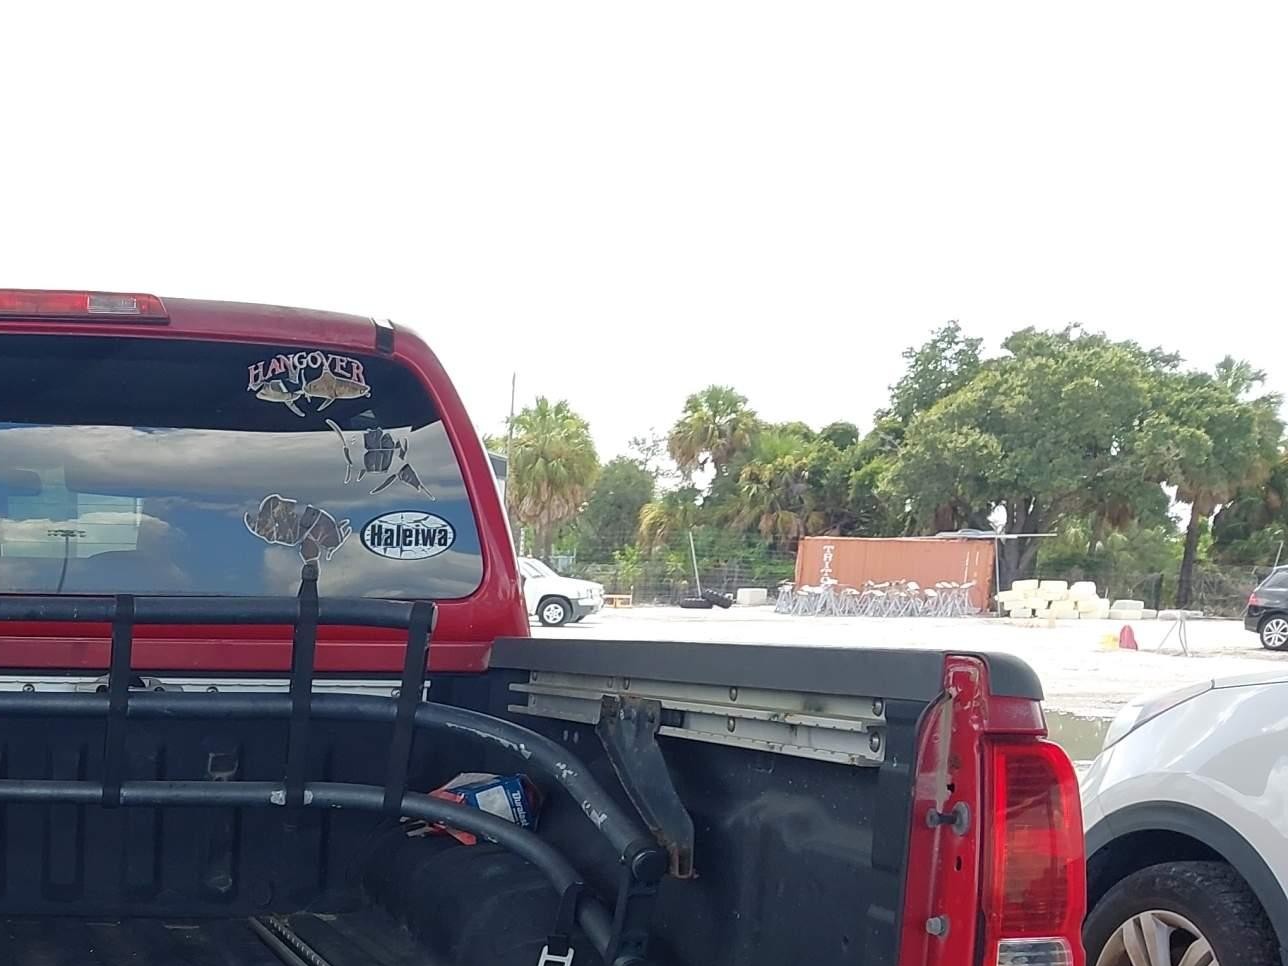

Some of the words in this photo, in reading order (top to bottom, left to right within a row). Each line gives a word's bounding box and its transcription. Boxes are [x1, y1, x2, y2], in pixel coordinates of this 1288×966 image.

[247, 351, 366, 391] HANGOVER
[370, 523, 448, 547] Haleiwa
[512, 790, 530, 826] Duralast
